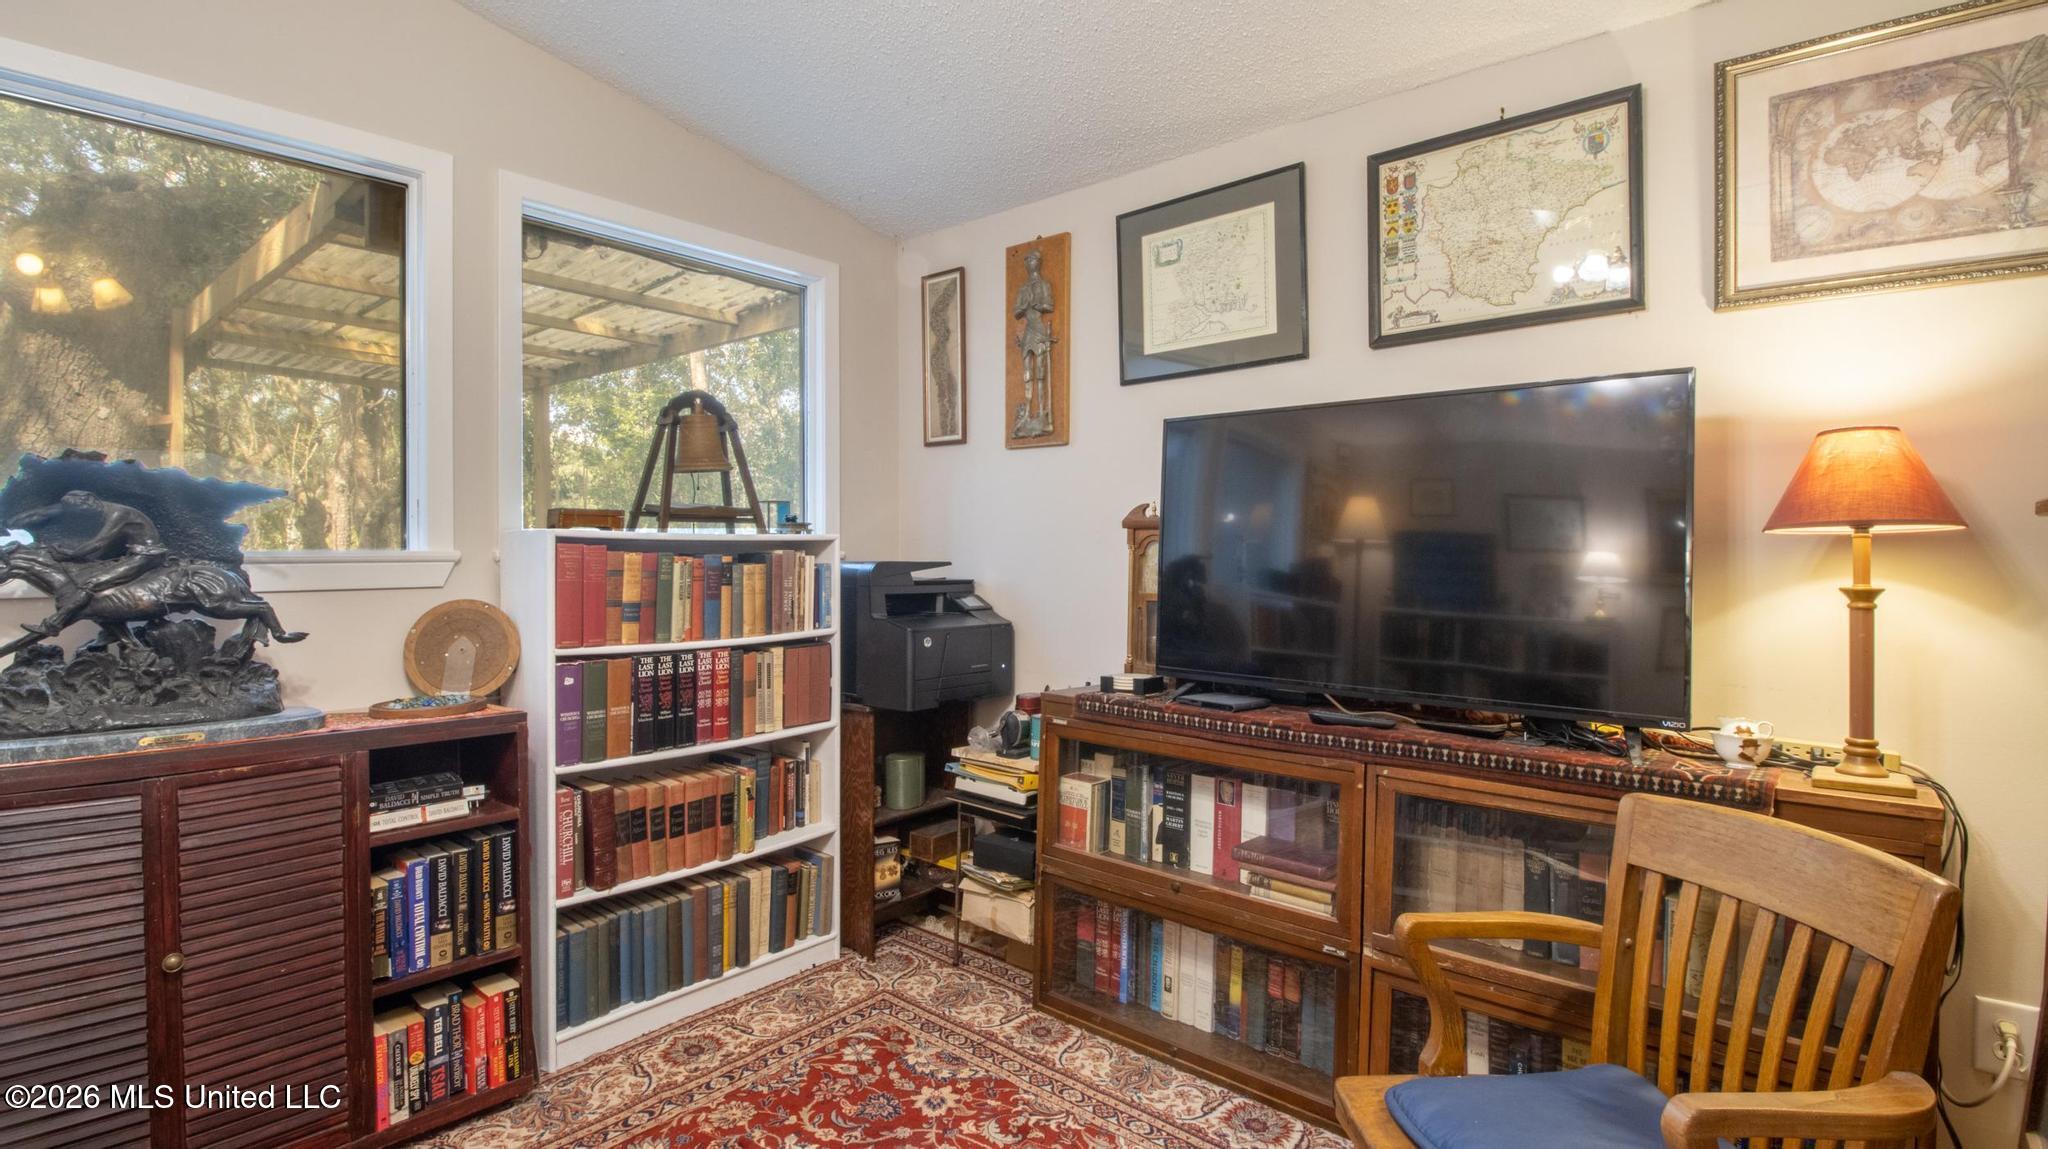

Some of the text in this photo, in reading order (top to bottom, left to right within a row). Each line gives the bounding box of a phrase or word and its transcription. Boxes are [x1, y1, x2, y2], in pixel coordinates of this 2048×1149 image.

[380, 799, 411, 809] BALDACCI
[385, 793, 404, 802] DAVID
[563, 810, 573, 862] CHURCHILL
[459, 854, 468, 901] DAVID BALDACCI
[502, 837, 512, 898] DAVID BALDACCI
[438, 858, 448, 918] DAVID BALDACCI
[414, 901, 425, 926] TOTAL
[415, 926, 425, 960] CONTROL
[451, 1004, 461, 1025] BRAD
[434, 1017, 443, 1055] TED BELL
[452, 1025, 463, 1050] THOR
[431, 1065, 446, 1100] TSAR
